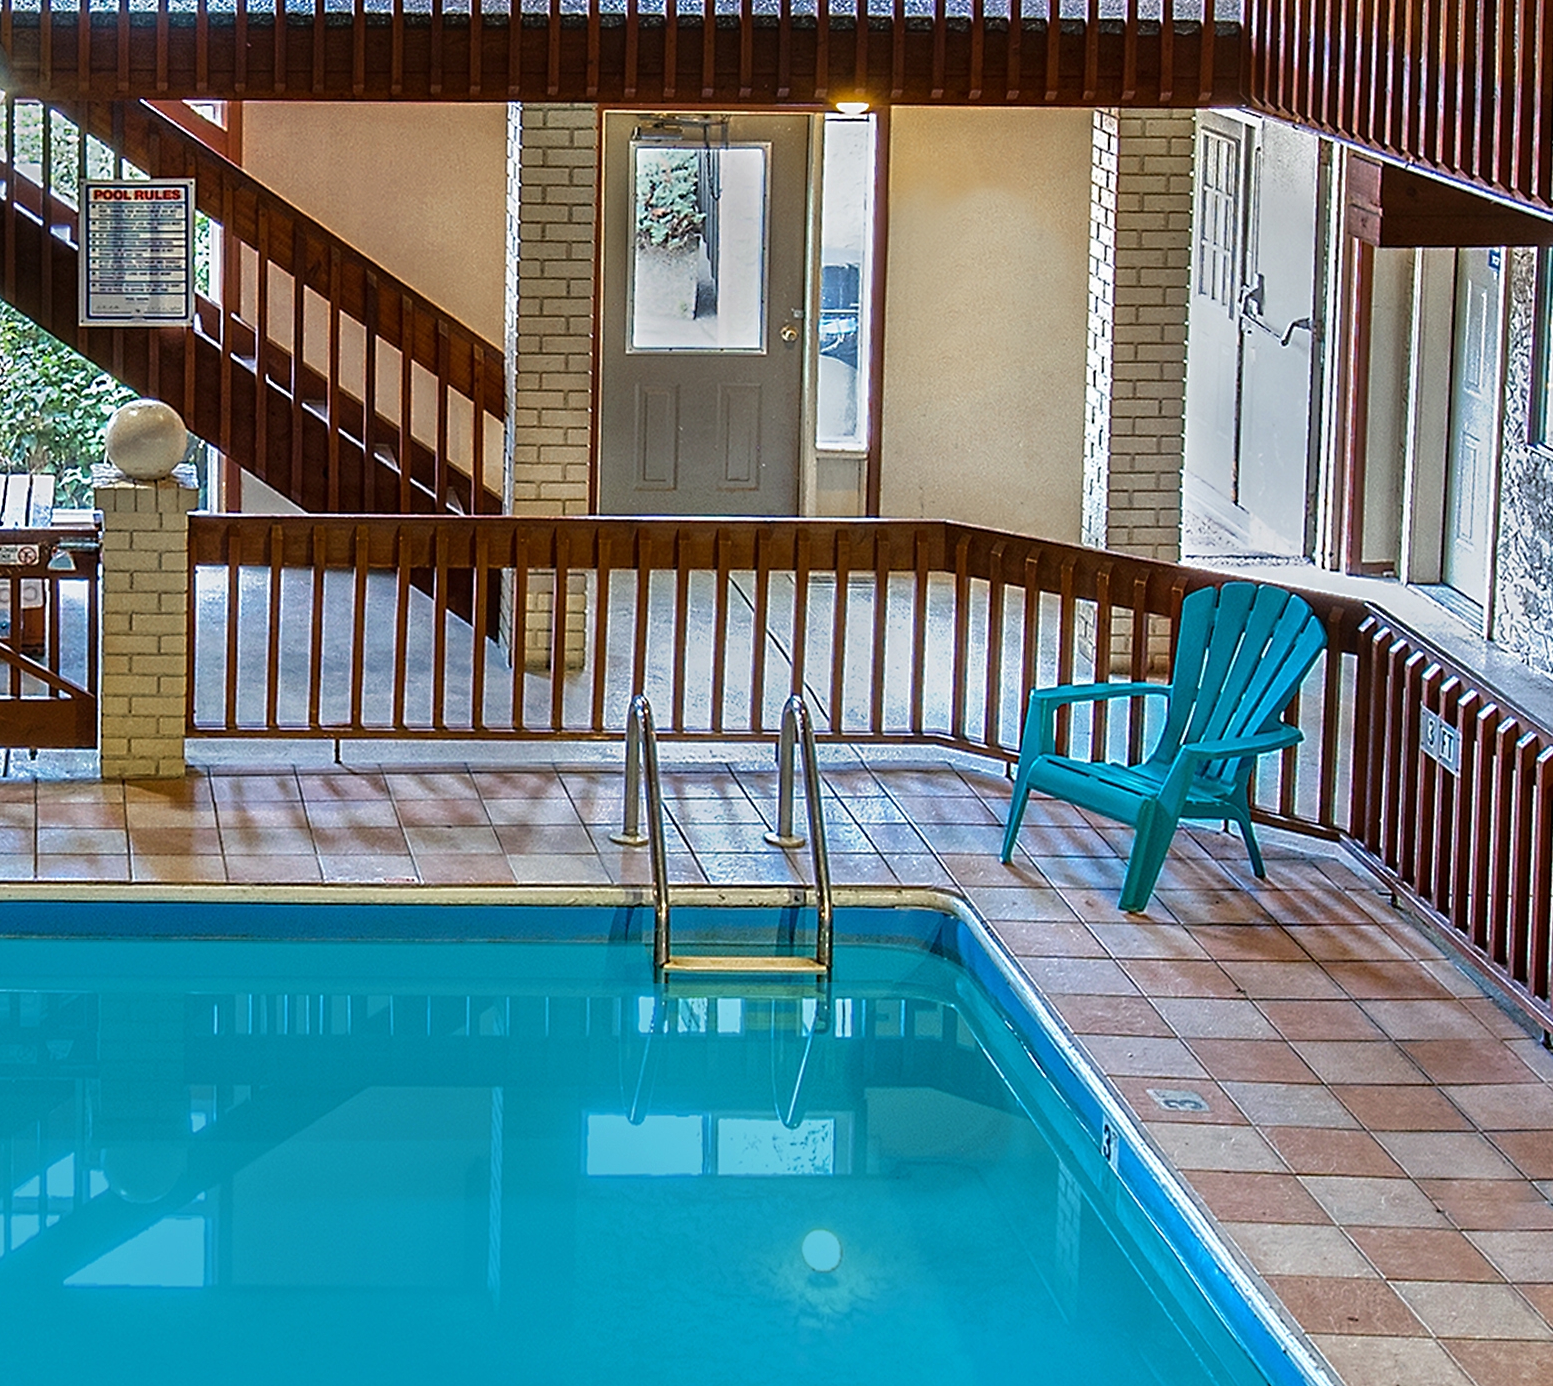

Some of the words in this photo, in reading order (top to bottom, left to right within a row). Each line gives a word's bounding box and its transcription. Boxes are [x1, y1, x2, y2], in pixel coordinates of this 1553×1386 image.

[93, 190, 131, 201] POOL
[134, 190, 181, 201] RULES
[1440, 729, 1454, 763] FT
[1103, 1124, 1111, 1162] 3
